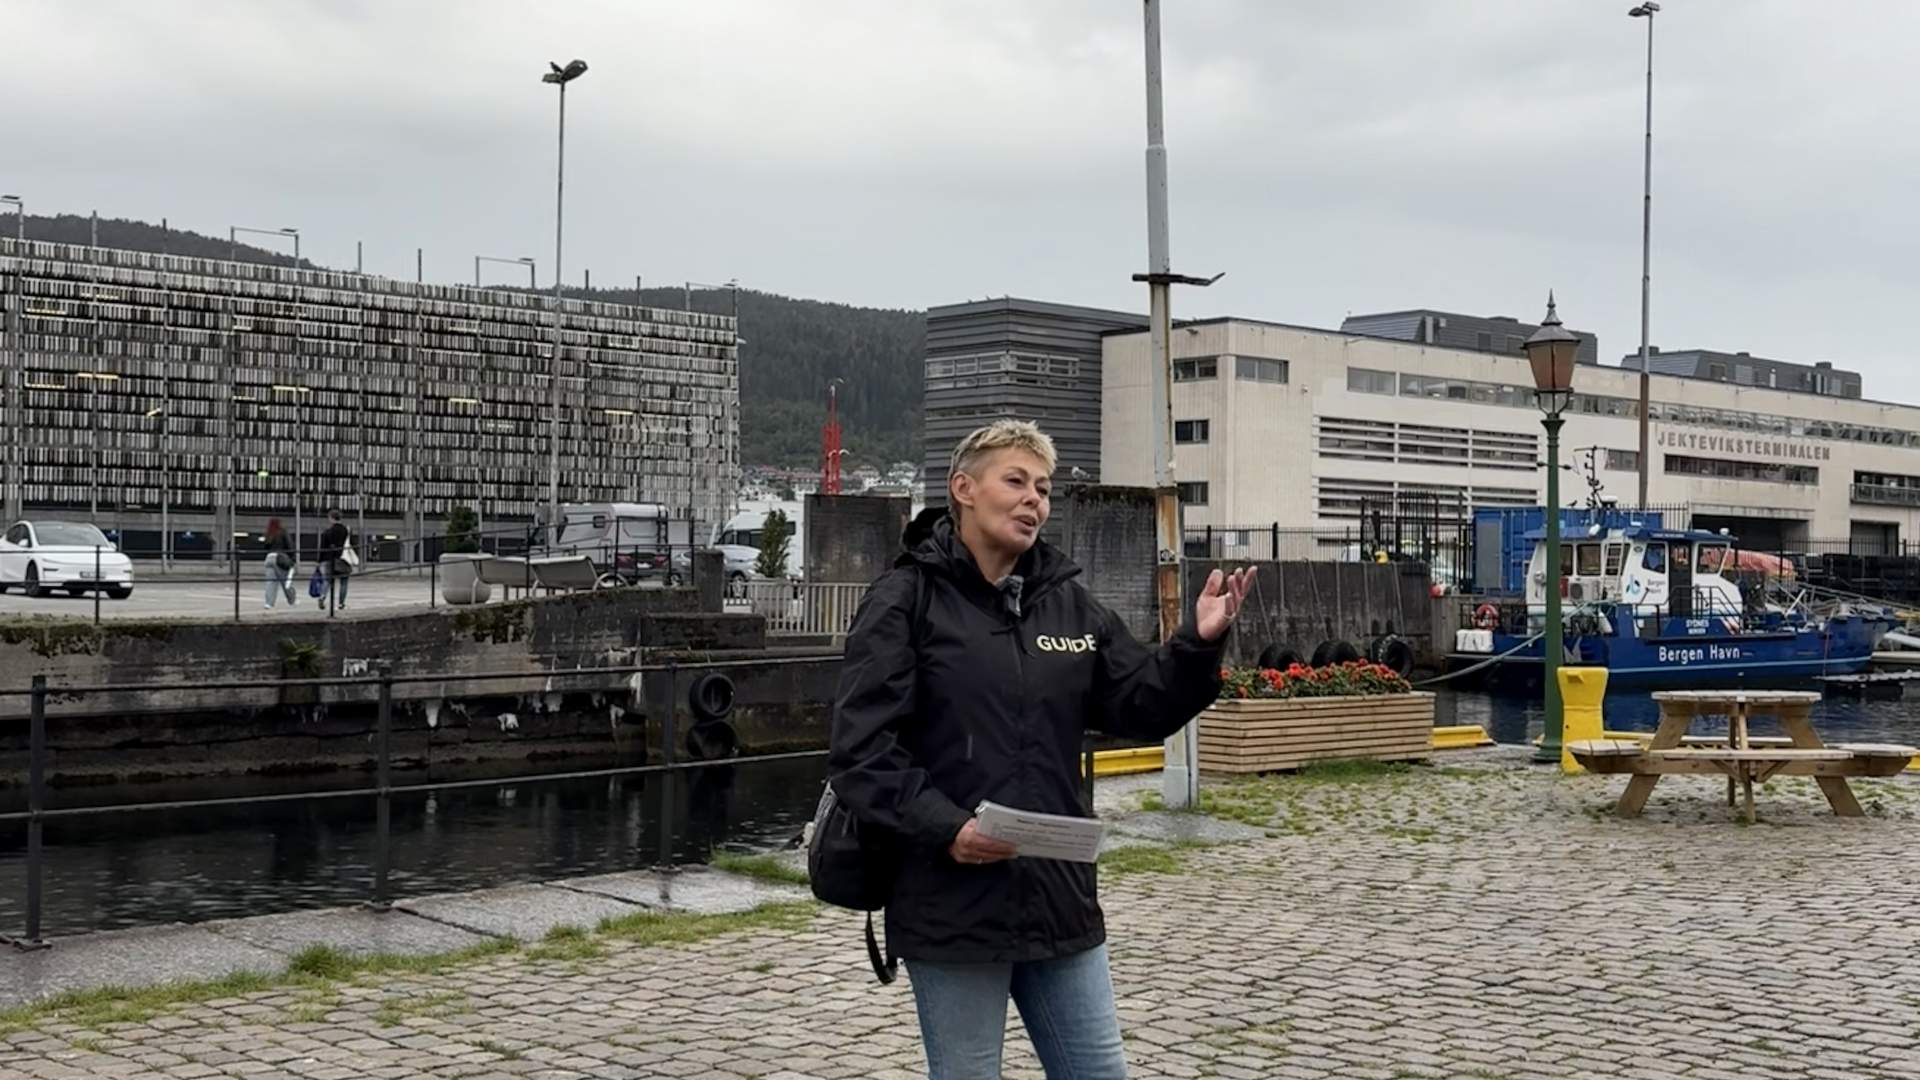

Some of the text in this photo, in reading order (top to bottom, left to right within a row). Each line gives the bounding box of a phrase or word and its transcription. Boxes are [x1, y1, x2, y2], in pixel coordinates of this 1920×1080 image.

[1657, 431, 1831, 460] JEKTEVIKSTERMINALEN
[1036, 634, 1097, 653] GUIDE
[1659, 644, 1740, 665] Bergen Havn
